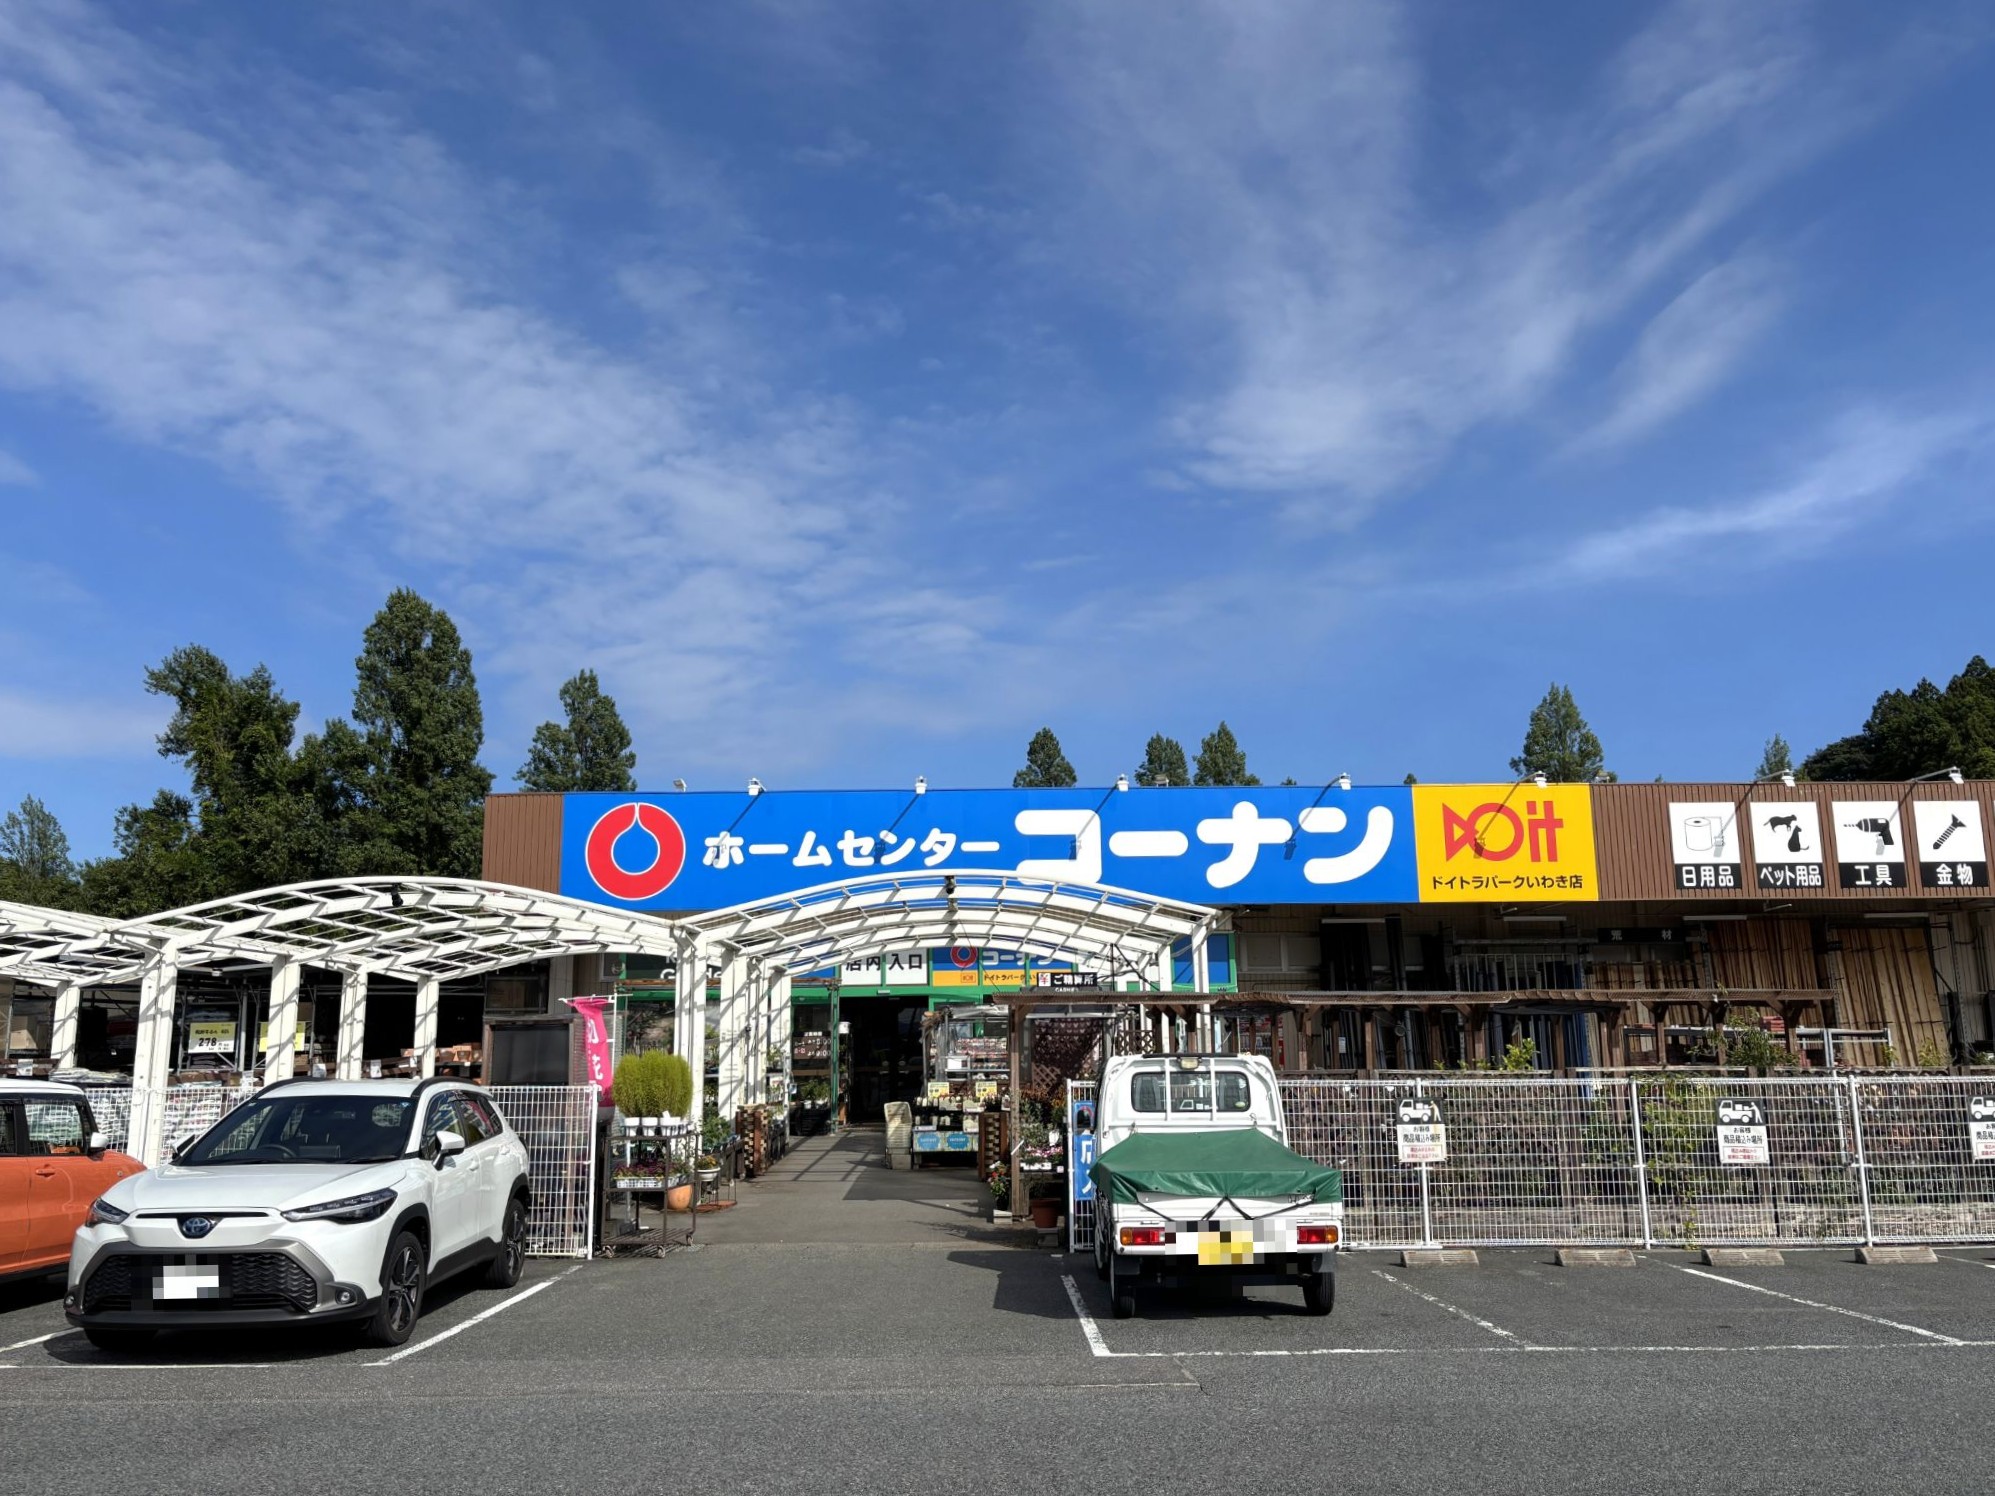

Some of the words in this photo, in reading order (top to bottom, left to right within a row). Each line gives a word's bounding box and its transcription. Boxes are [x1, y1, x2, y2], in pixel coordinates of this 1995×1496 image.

[703, 828, 1000, 868] ホームセンター
[1015, 800, 1394, 889] コーナン
[1432, 875, 1583, 890] ドイトラパークいわき店
[1682, 865, 1734, 888] 日用品
[1760, 864, 1822, 887] ペット用品
[1855, 864, 1893, 886] 工具
[1936, 863, 1974, 886] 金物
